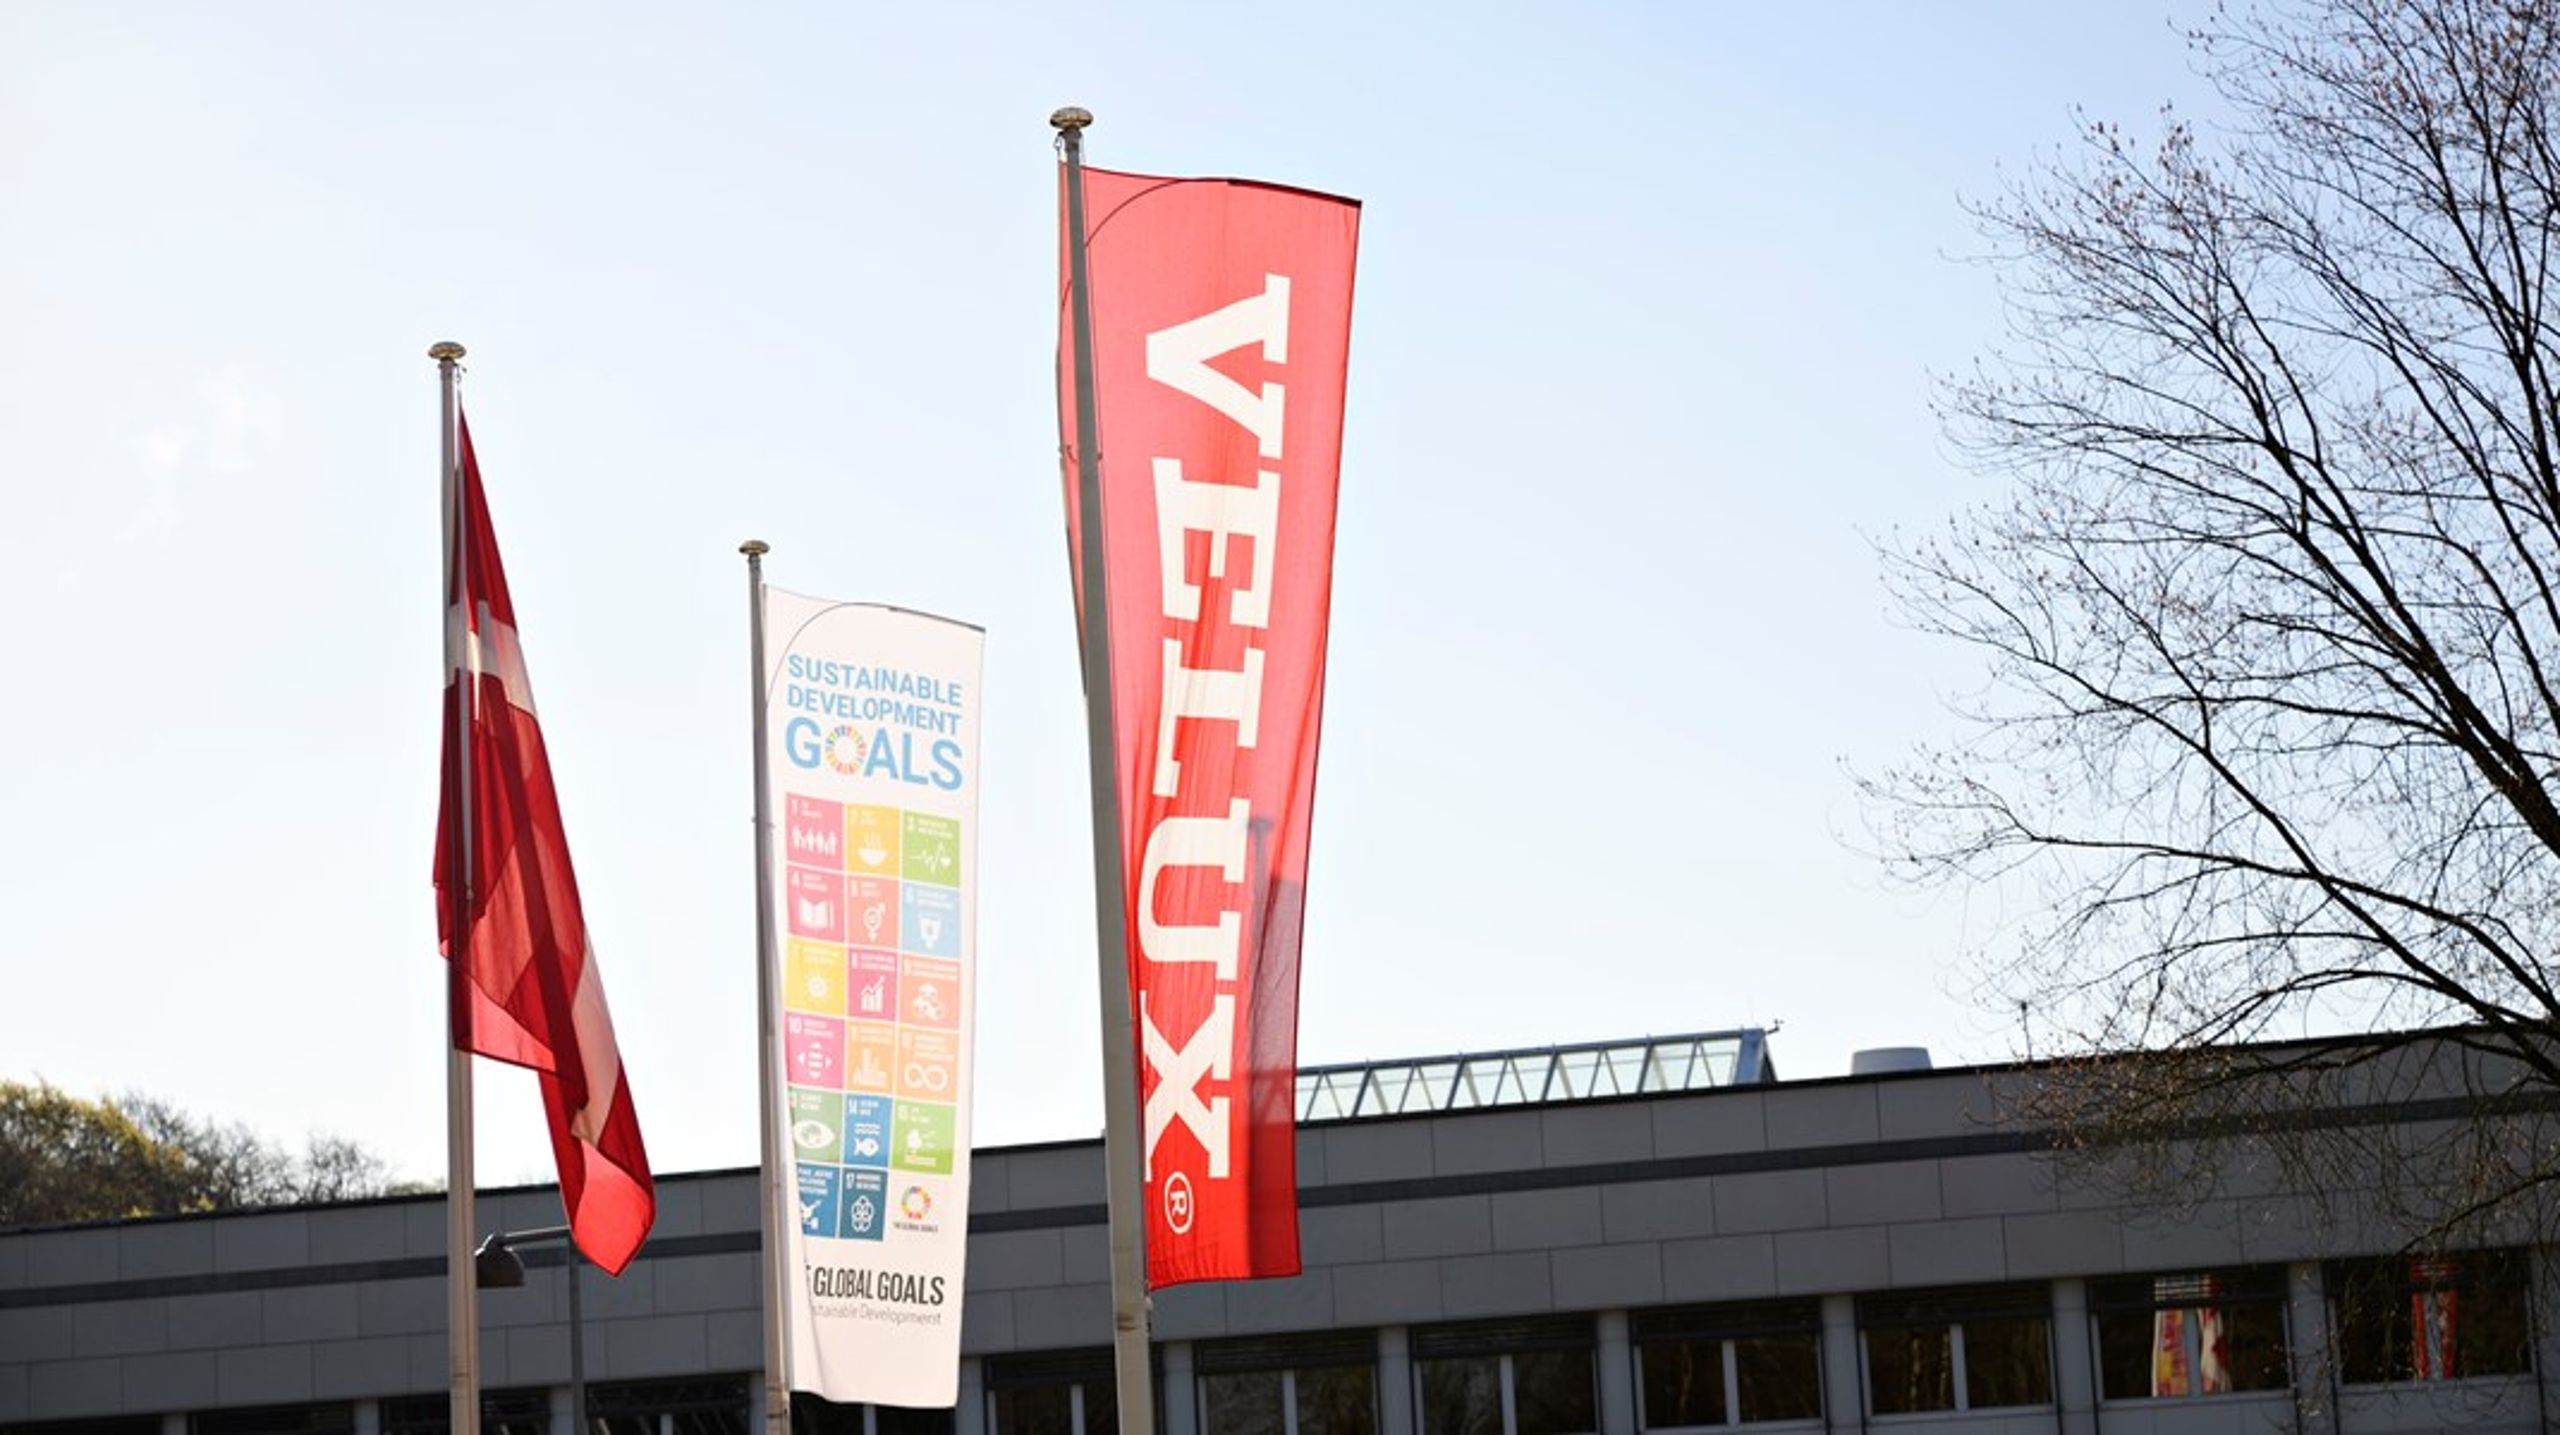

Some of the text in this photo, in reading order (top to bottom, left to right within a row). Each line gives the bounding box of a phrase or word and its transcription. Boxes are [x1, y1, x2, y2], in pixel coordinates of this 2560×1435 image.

[787, 654, 963, 707] SUSTAINABLE
[786, 683, 962, 736] DEVELOPMENT
[785, 715, 963, 791] GOALS
[813, 1266, 874, 1300] GLOBAL
[877, 1271, 945, 1306] GOALS
[861, 1303, 942, 1326] Development
